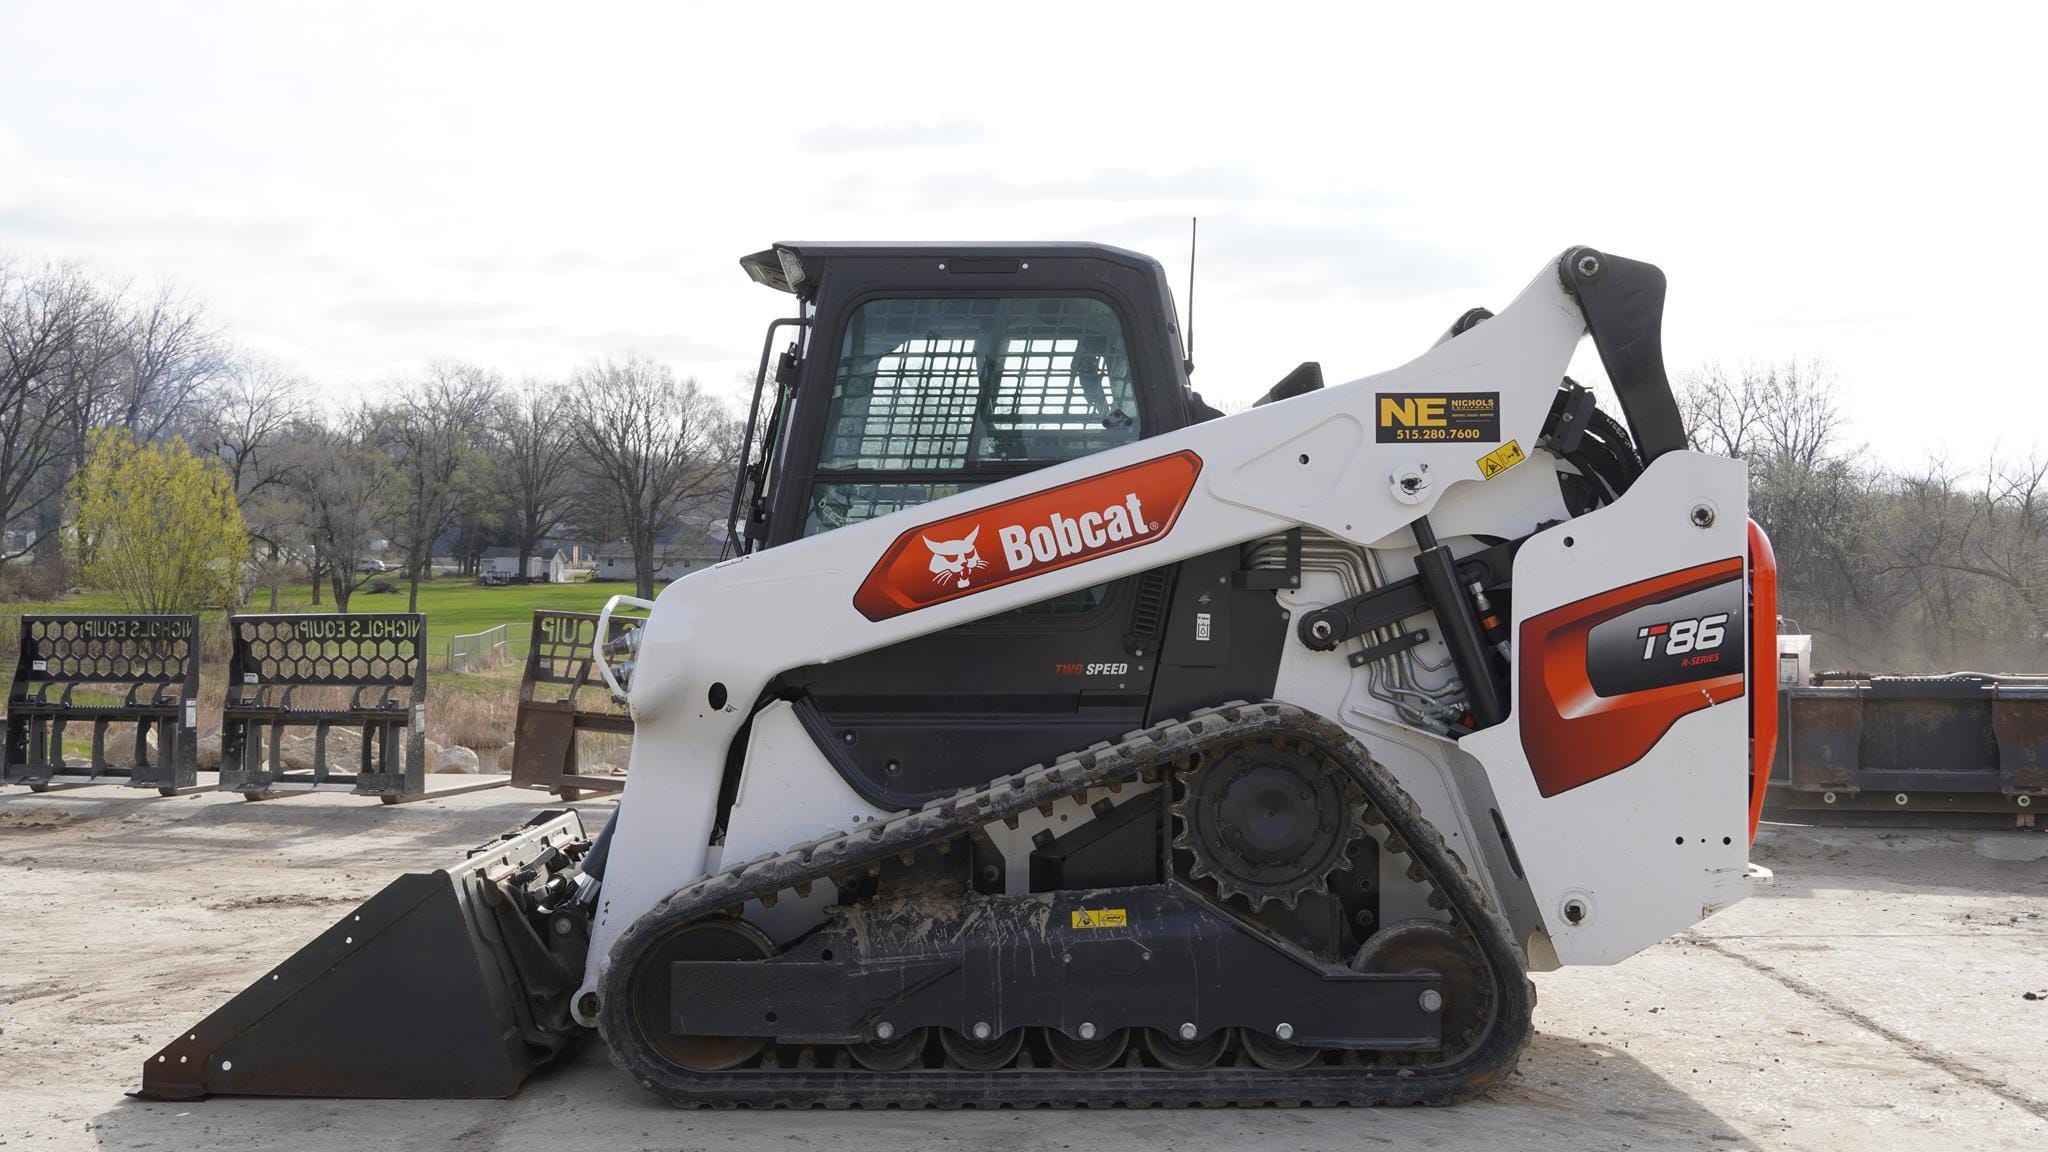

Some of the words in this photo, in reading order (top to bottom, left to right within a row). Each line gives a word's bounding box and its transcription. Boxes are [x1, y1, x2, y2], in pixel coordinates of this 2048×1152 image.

[1451, 399, 1494, 407] NICHOLS
[1381, 398, 1447, 427] NE
[1396, 429, 1480, 440] 515.280.7600
[999, 493, 1149, 571] Bobcat
[1639, 613, 1729, 660] T86
[1681, 653, 1720, 667] R-SERIES
[1055, 663, 1084, 675] TWO
[1086, 663, 1128, 675] SPEED
